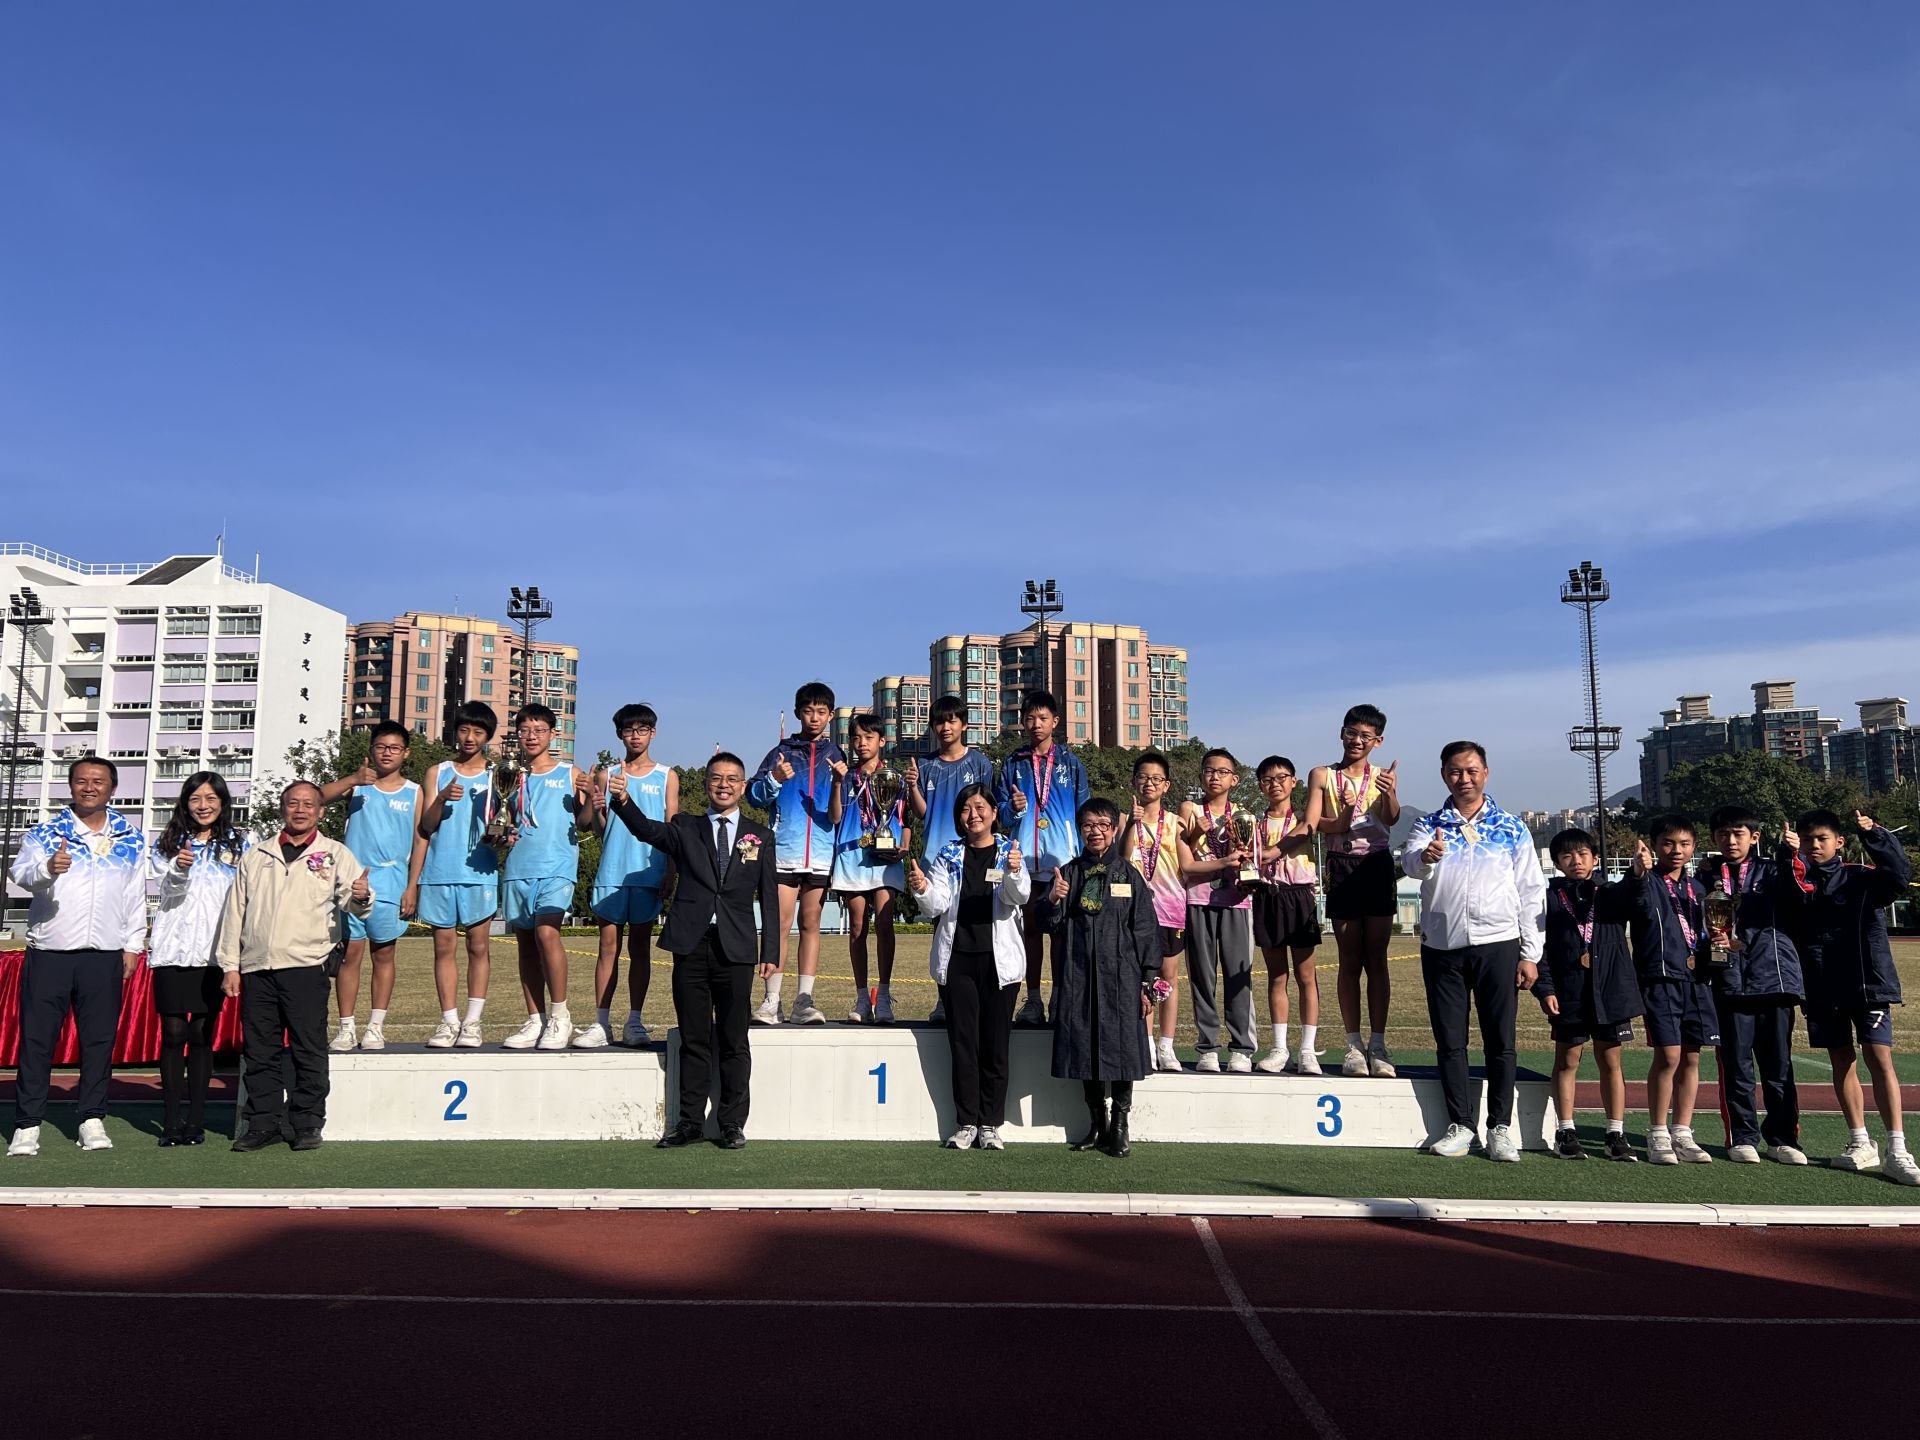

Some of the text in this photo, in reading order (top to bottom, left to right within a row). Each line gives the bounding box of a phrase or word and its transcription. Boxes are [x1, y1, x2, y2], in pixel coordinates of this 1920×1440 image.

[544, 778, 565, 789] MKC
[641, 783, 661, 795] MKC
[389, 798, 410, 812] MKC
[1869, 1010, 1885, 1029] 7
[868, 1062, 887, 1104] 1
[443, 1079, 468, 1121] 2
[1316, 1094, 1343, 1138] 3
